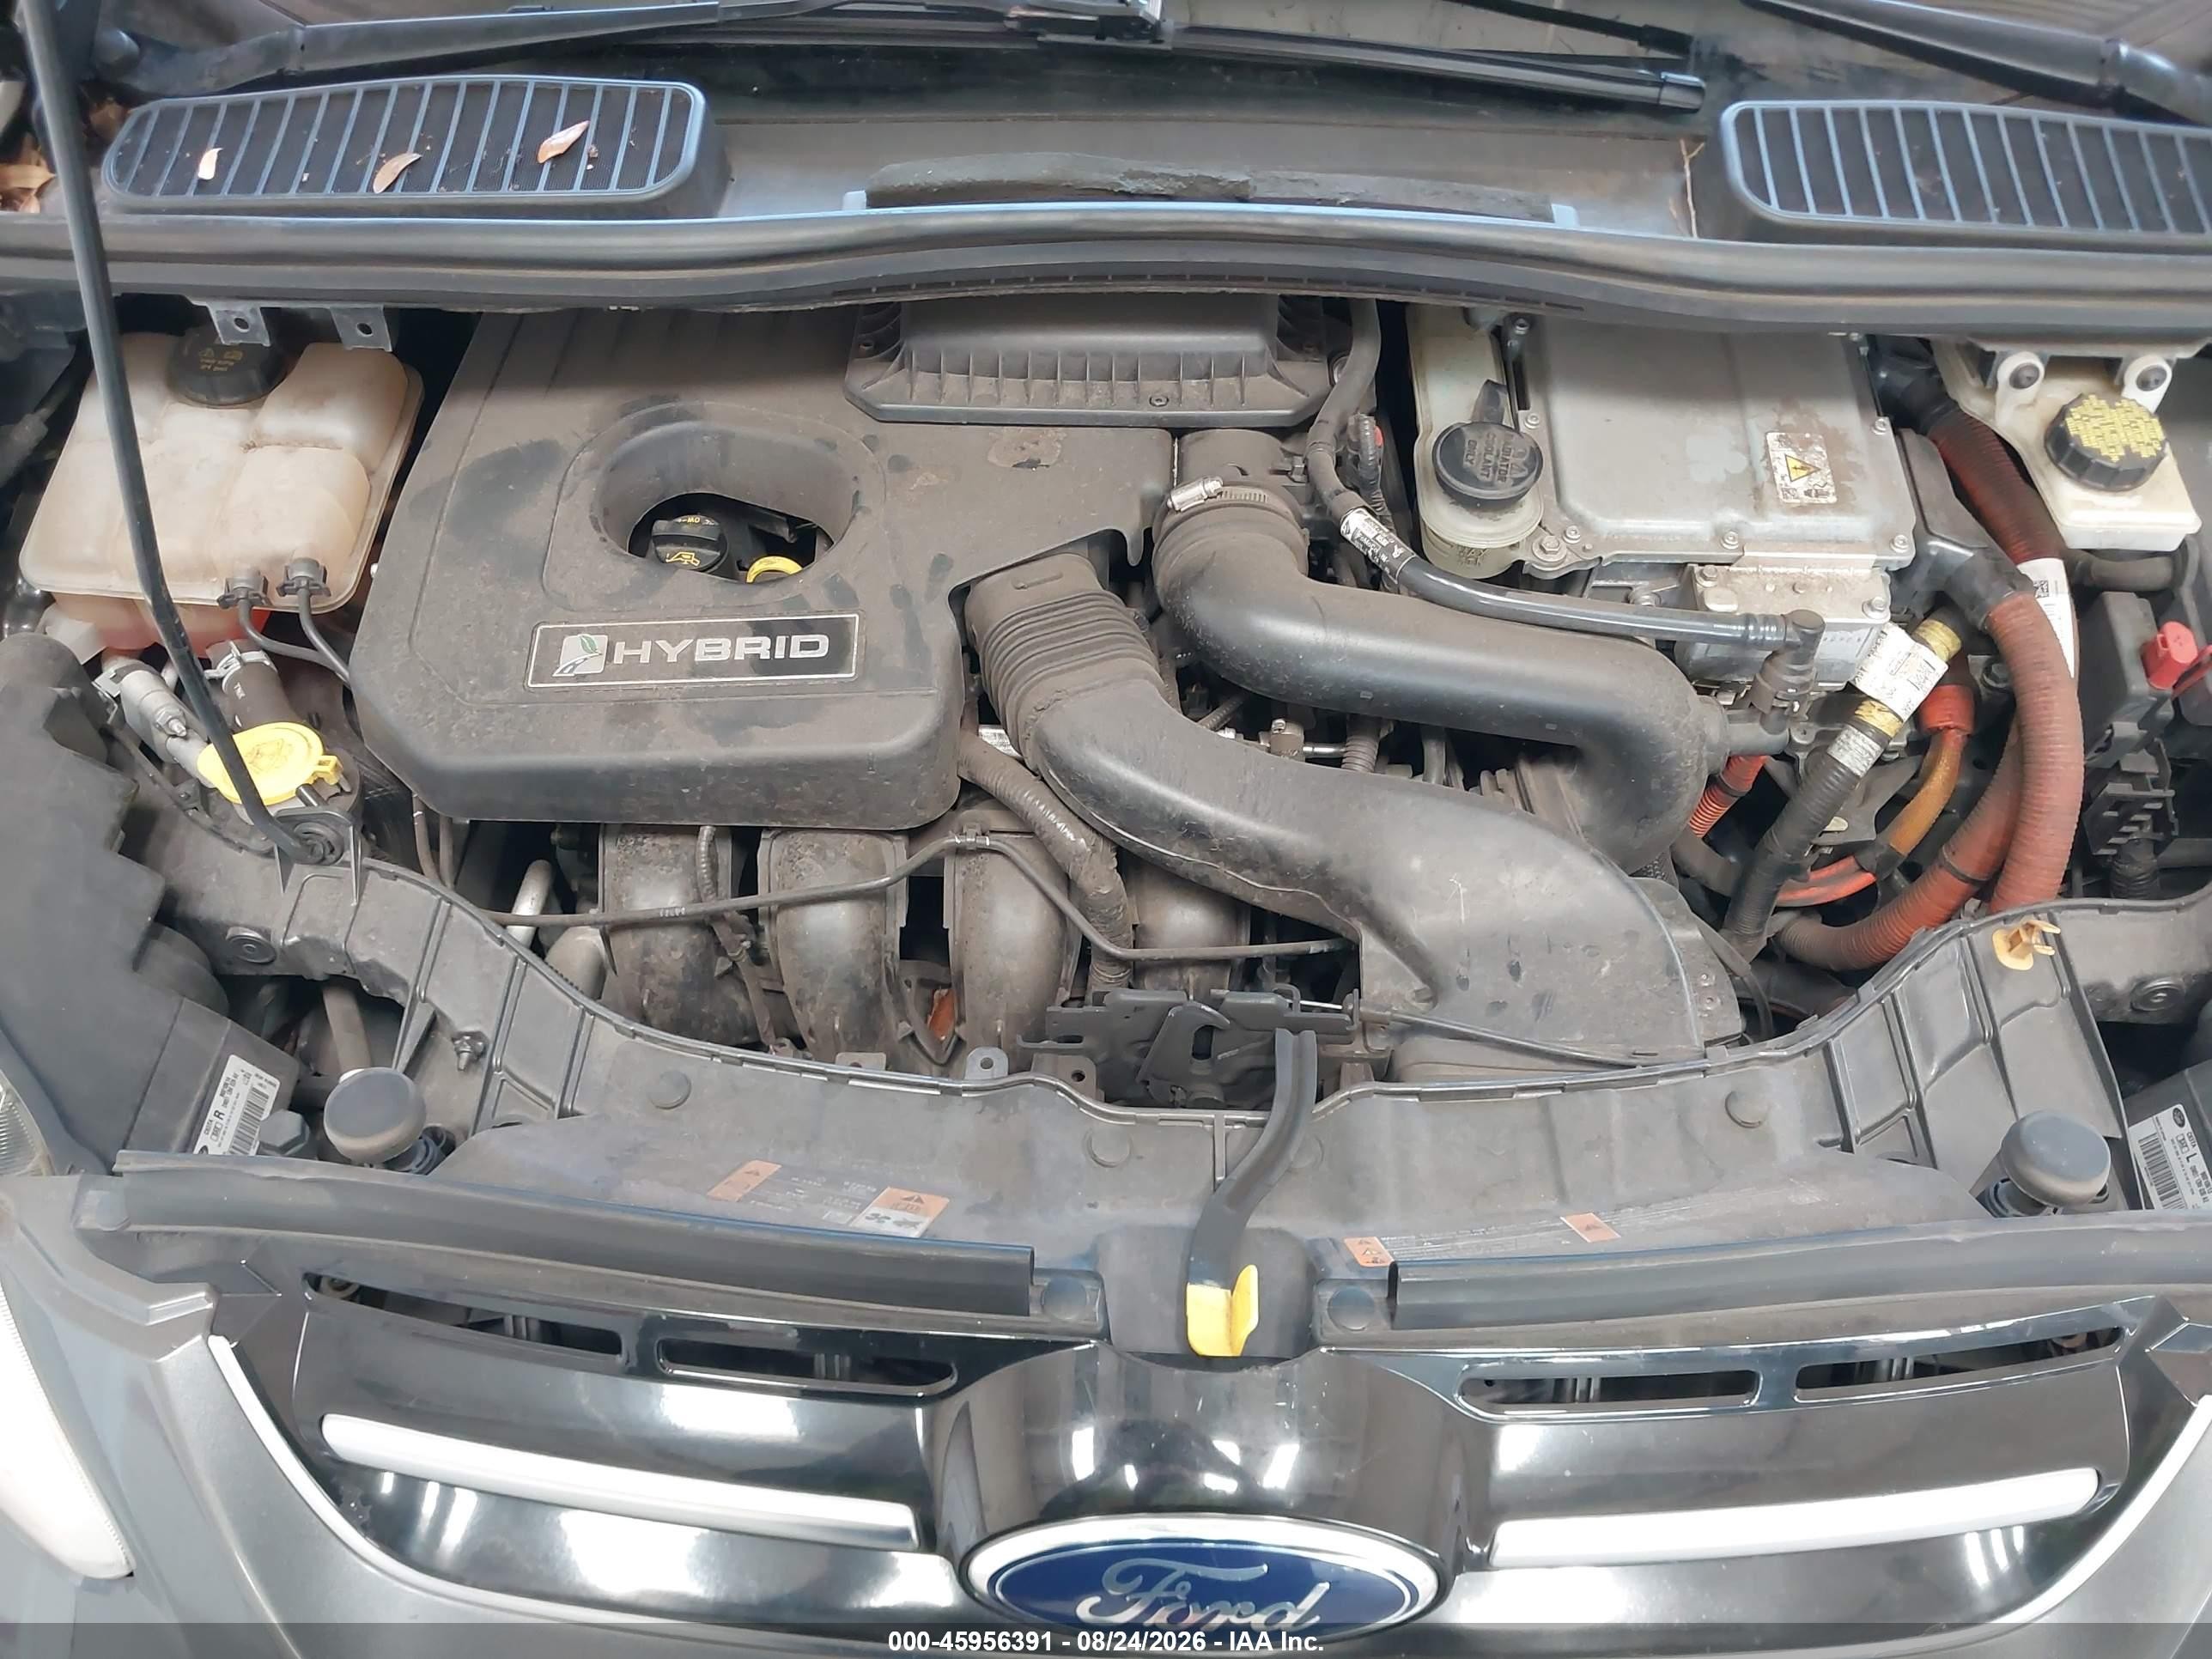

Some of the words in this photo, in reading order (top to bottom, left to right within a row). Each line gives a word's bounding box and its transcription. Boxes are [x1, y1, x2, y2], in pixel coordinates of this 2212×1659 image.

[1481, 432, 1497, 478] COOLANT
[613, 635, 830, 664] HYBRID
[213, 1109, 225, 1120] R
[2186, 1152, 2197, 1163] L
[1076, 1558, 1330, 1631] Ford
